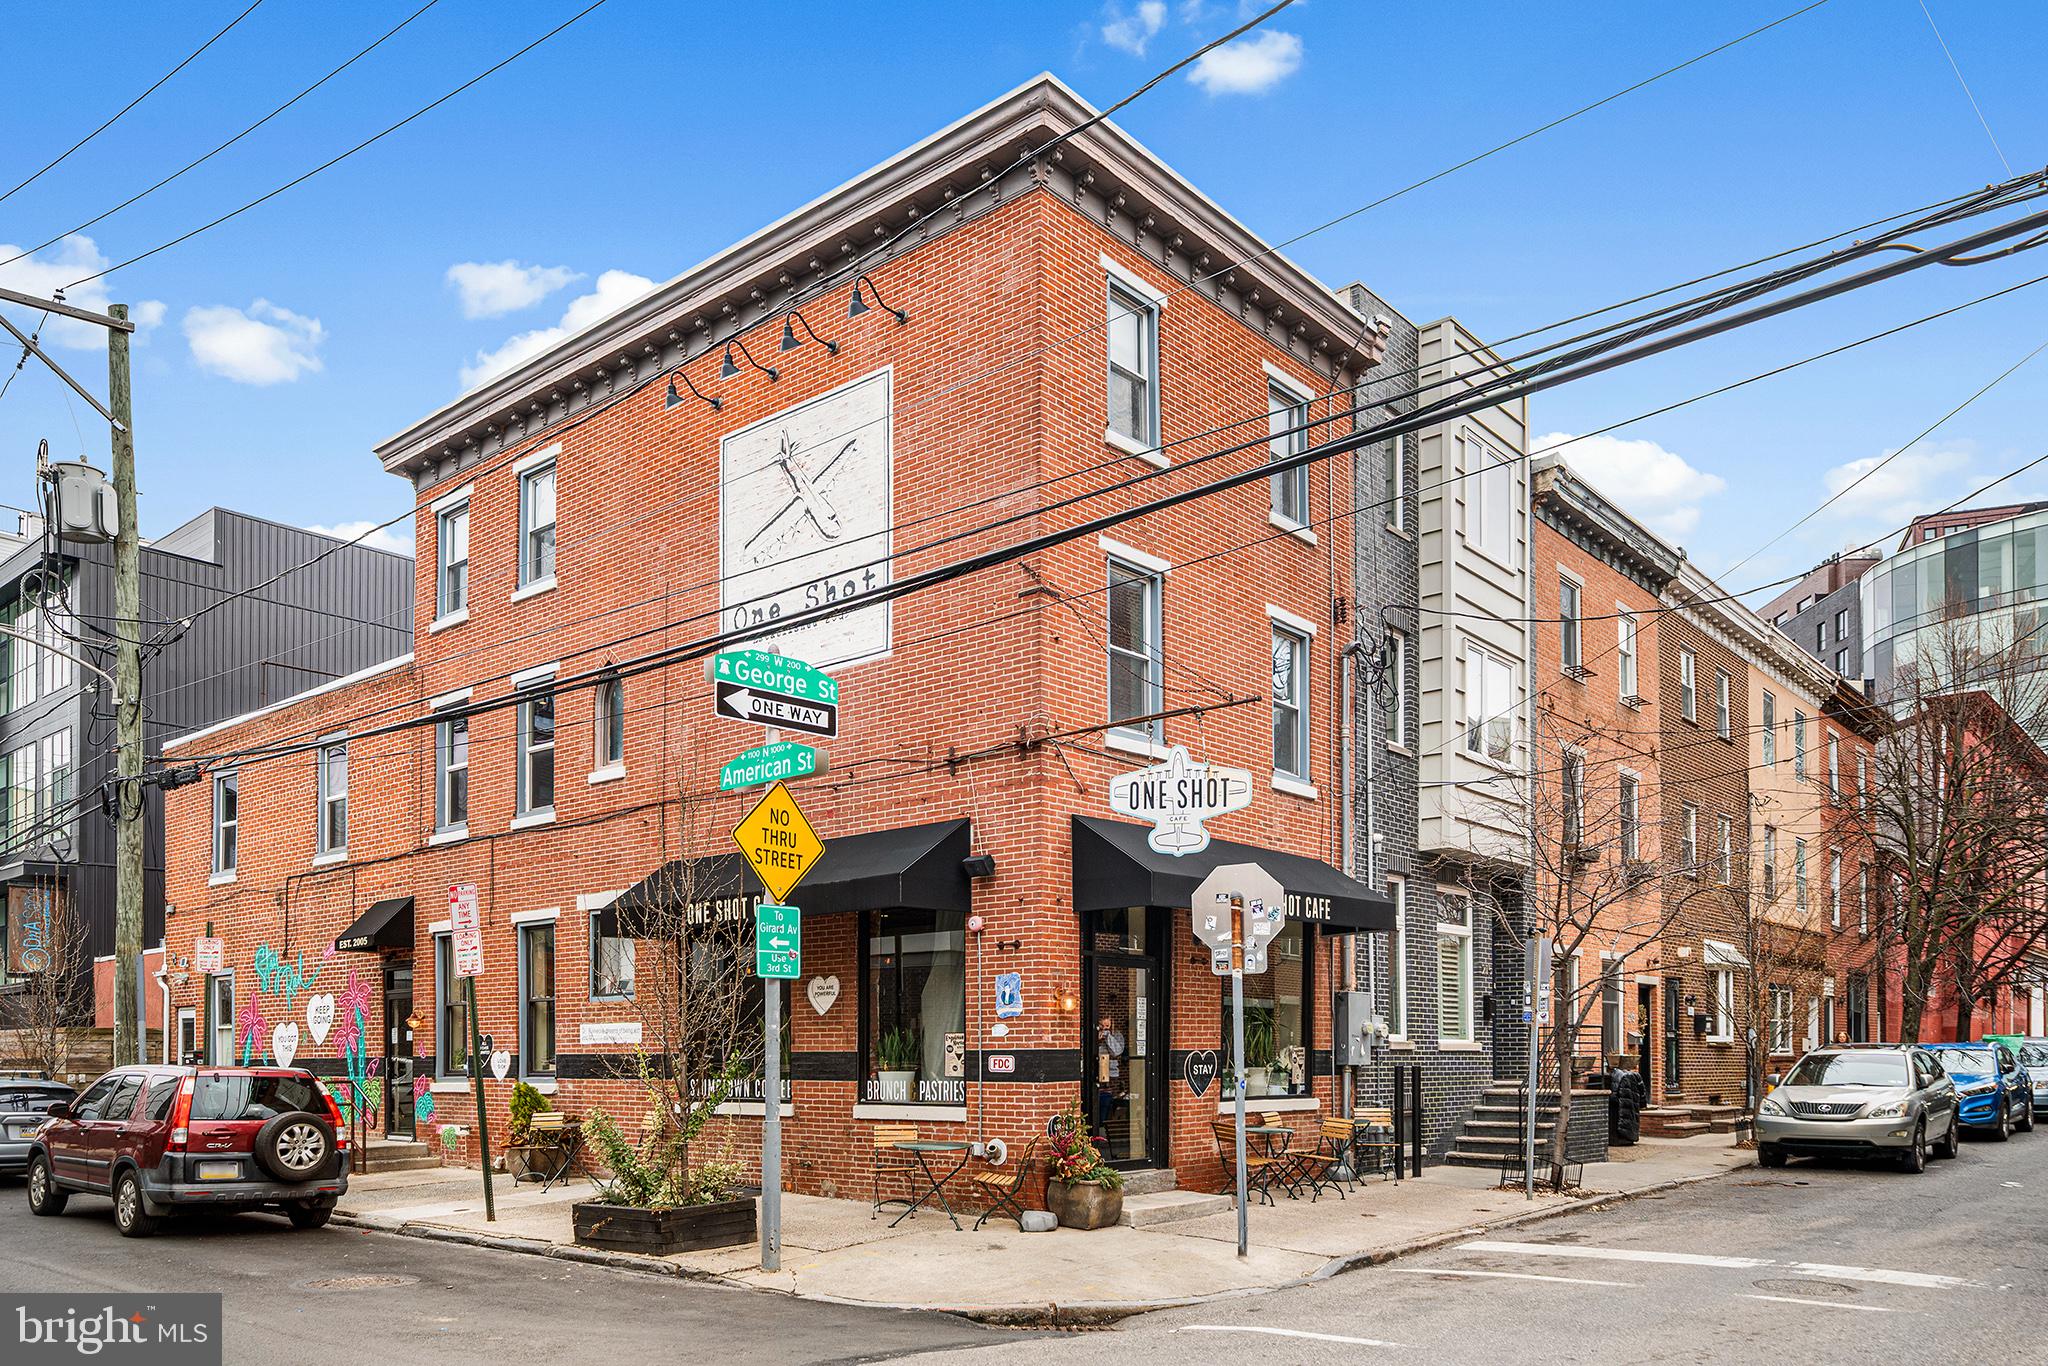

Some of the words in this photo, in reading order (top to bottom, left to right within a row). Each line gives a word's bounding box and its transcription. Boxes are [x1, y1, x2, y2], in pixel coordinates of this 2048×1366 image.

[733, 602, 781, 629] One
[805, 568, 876, 609] Shot
[755, 653, 770, 663] 299
[774, 656, 784, 667] W
[787, 660, 801, 670] 200
[735, 660, 807, 694] George
[818, 680, 836, 700] St
[752, 699, 784, 717] ONE
[789, 706, 822, 724] WAY
[747, 749, 760, 759] 1100
[762, 747, 769, 758] N
[770, 744, 785, 754] 1000
[722, 758, 791, 787] American
[797, 751, 812, 771] St
[1129, 780, 1167, 810] ONE
[1177, 777, 1230, 809] SHOT
[770, 808, 789, 826] NO
[761, 827, 797, 848] THRU
[754, 847, 803, 870] STREET
[458, 902, 470, 910] ANY
[458, 910, 472, 919] TIME
[686, 901, 711, 925] ONE
[716, 896, 748, 922] SHOT
[1305, 896, 1331, 920] CAFE
[774, 910, 784, 921] To
[759, 922, 785, 934] Girard
[787, 924, 798, 935] Av
[339, 938, 352, 949] EST.
[353, 936, 368, 947] 2005
[771, 953, 787, 963] Use
[767, 963, 780, 973] 3rd
[783, 964, 791, 973] St
[315, 1005, 330, 1015] KEEP
[313, 1015, 331, 1025] GOING
[993, 1058, 1010, 1069] FDC
[1193, 1064, 1213, 1075] STAY
[755, 1079, 791, 1098] COEE
[867, 1080, 907, 1101] BRUNCH
[919, 1080, 965, 1101] PASTRIES
